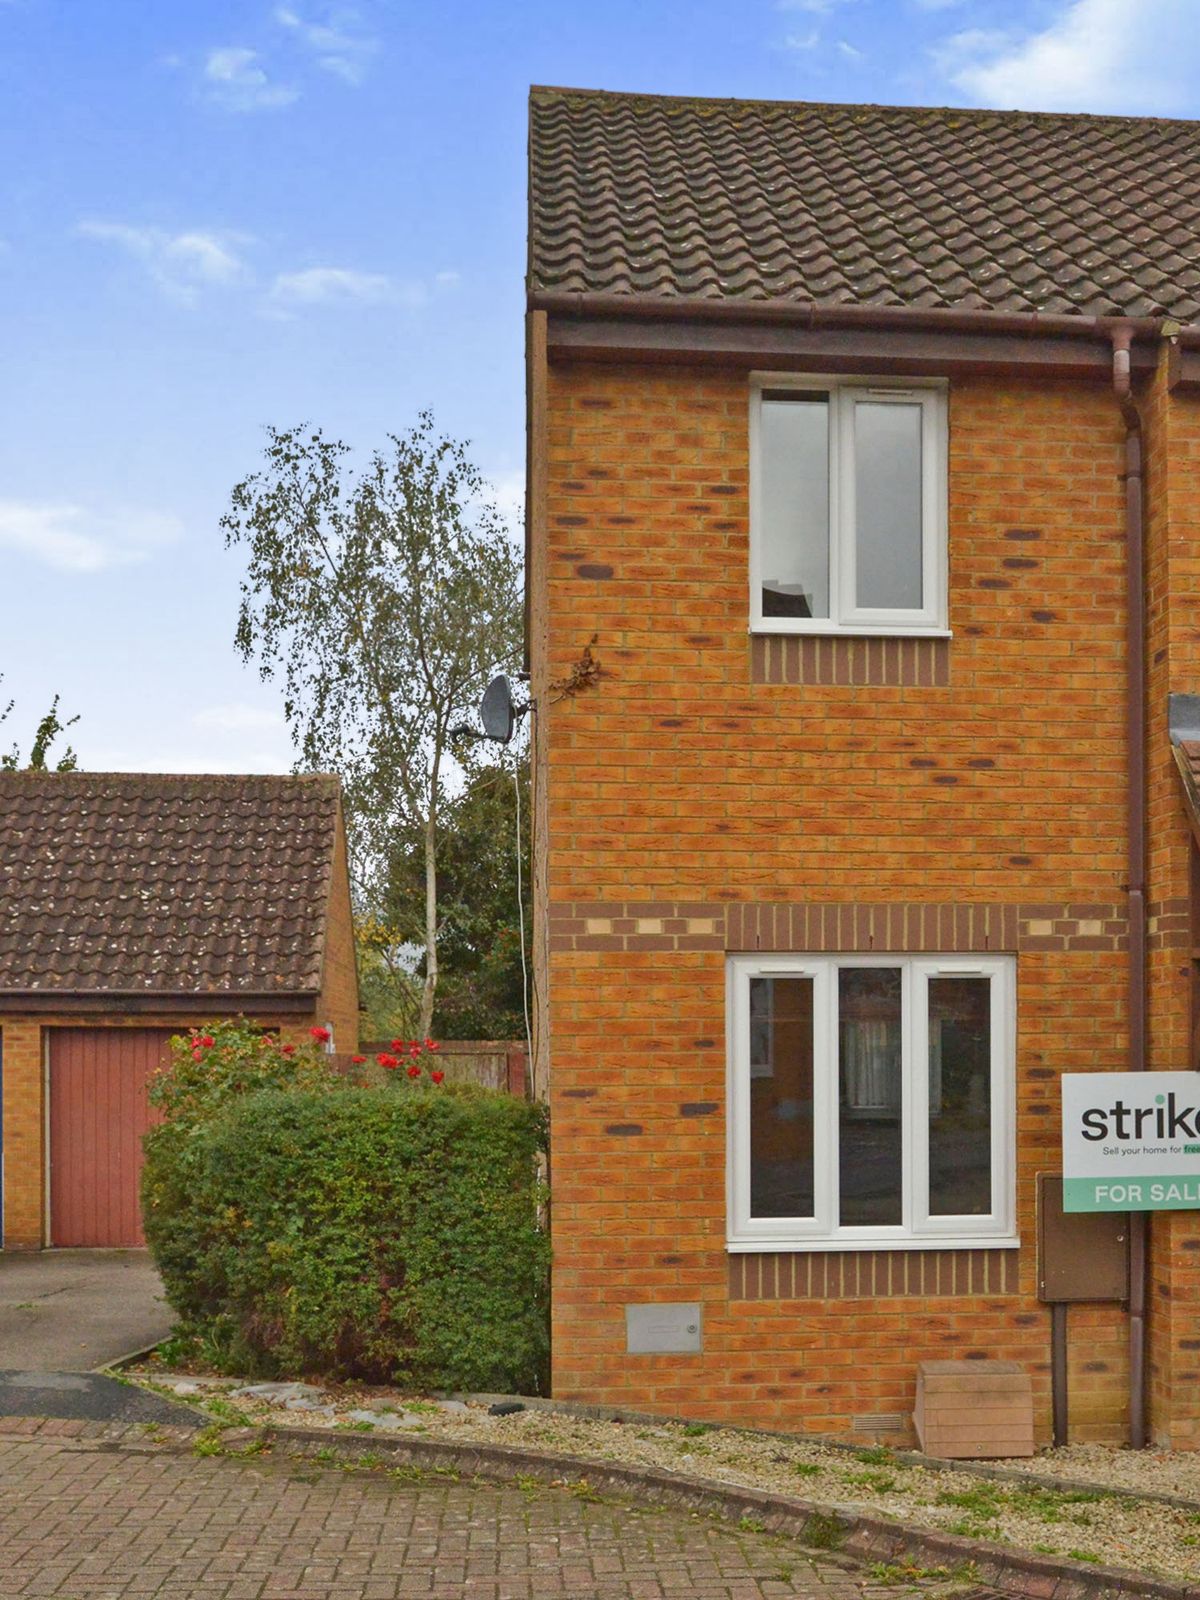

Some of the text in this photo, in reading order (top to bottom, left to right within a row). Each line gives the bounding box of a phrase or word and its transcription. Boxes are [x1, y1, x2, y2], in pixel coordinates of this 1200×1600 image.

[1102, 1146, 1119, 1156] Sell
[1121, 1147, 1141, 1156] your
[1142, 1146, 1168, 1154] home
[1170, 1145, 1182, 1154] for
[1095, 1184, 1143, 1203] FOR
